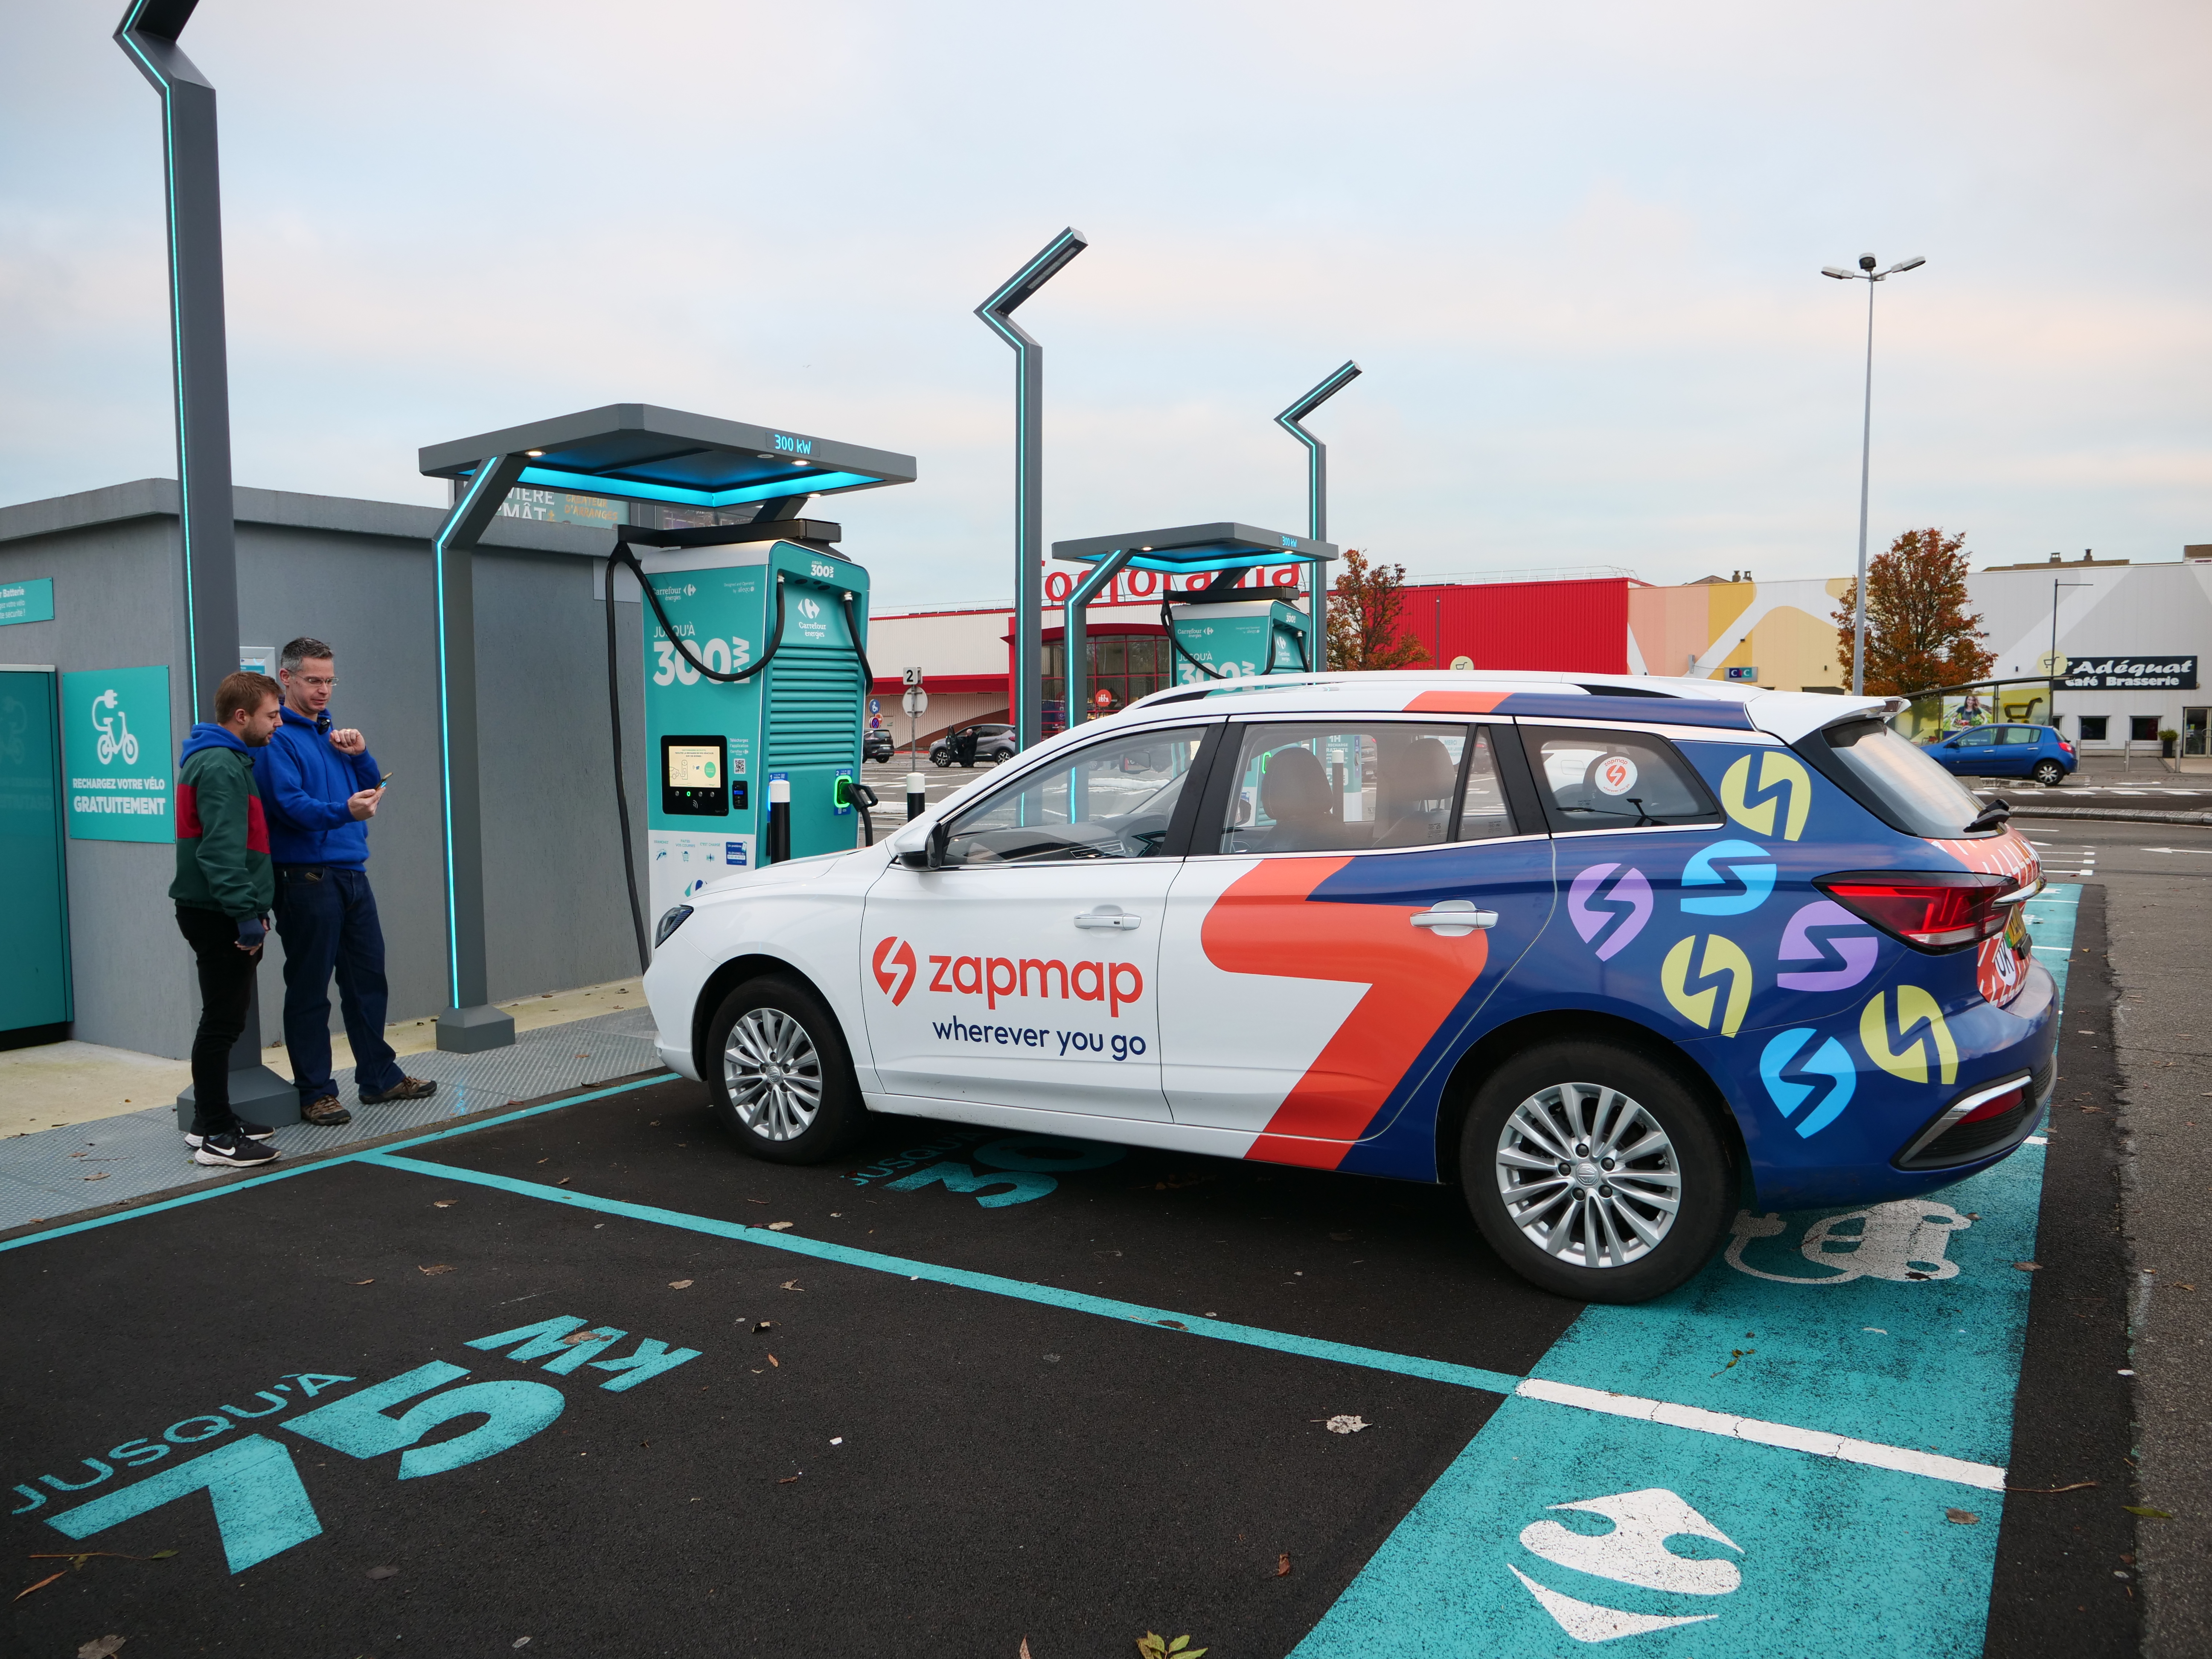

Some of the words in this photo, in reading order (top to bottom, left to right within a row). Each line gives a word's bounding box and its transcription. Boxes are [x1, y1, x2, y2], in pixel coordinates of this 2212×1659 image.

[774, 434, 794, 452] 300
[796, 438, 811, 455] kW
[1282, 536, 1290, 547] 300
[1290, 538, 1297, 548] kW
[811, 564, 830, 577] 300
[3, 586, 24, 597] Batterie
[665, 594, 681, 602] énergies
[654, 621, 696, 637] JUQU'À
[798, 622, 827, 630] Carrefour
[805, 629, 825, 639] énergies
[653, 638, 731, 686] 300
[1179, 651, 1213, 661] JUQU'À
[906, 669, 914, 683] 2
[2061, 660, 2193, 677] 'Adéquat
[2106, 676, 2180, 687] Brasserie
[73, 778, 116, 789] RECHARGEZ
[116, 778, 143, 789] VOTRE
[143, 776, 165, 790] VÉLO
[73, 795, 166, 815] GRATUITEMENT
[1996, 938, 2014, 977] UK
[928, 954, 1144, 1018] zapmap
[932, 1015, 1050, 1048] wherever
[1056, 1030, 1104, 1056] you
[1111, 1035, 1147, 1062] go
[11, 1372, 356, 1516] JUSQU'À
[43, 1359, 566, 1576] 75
